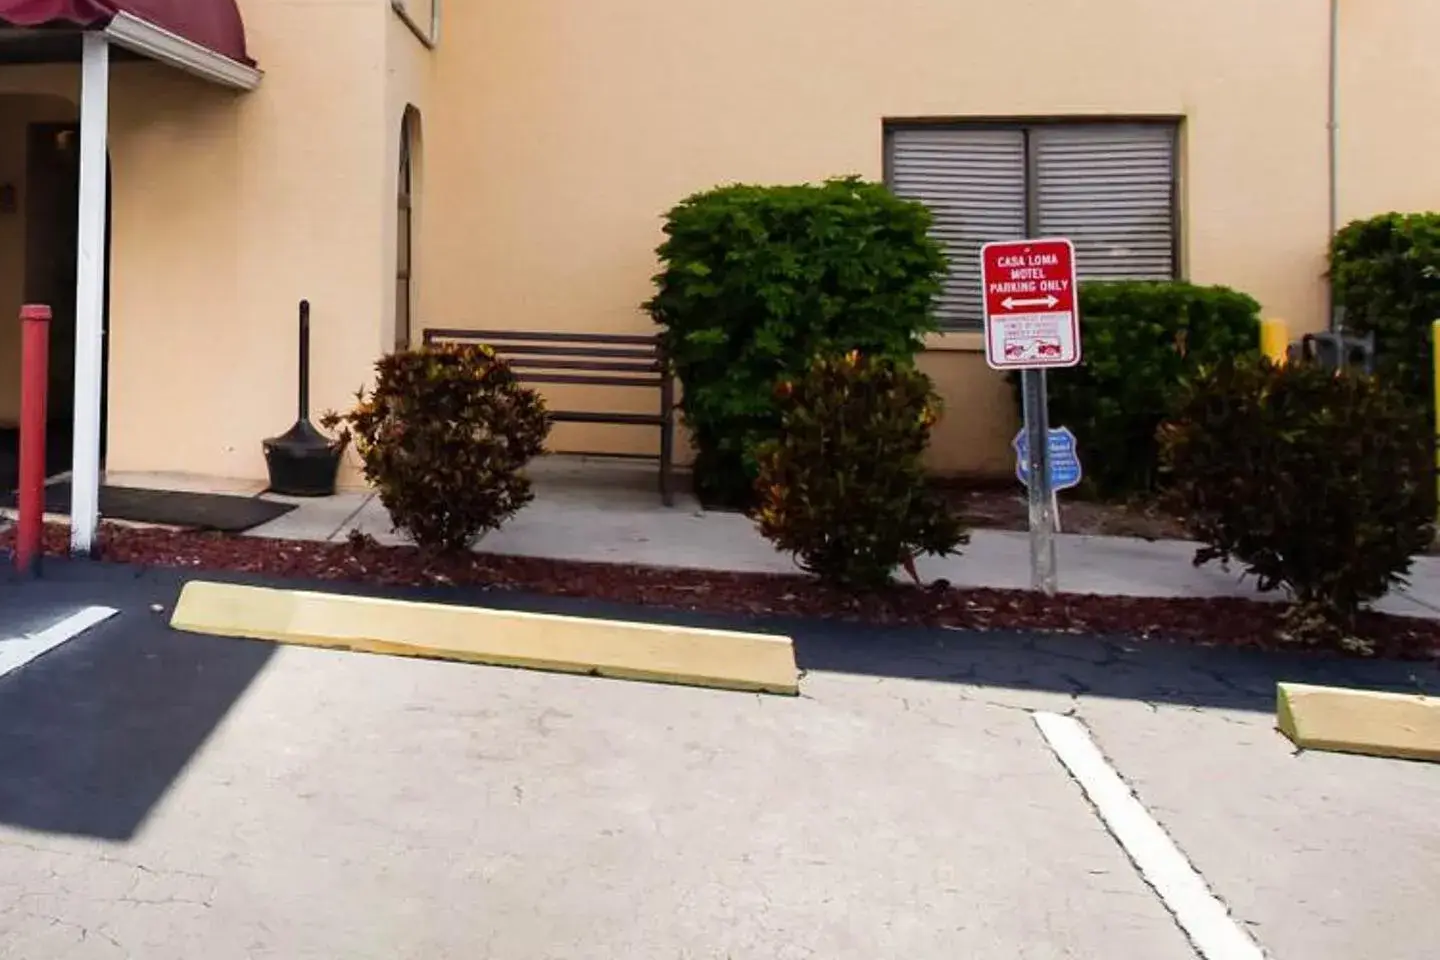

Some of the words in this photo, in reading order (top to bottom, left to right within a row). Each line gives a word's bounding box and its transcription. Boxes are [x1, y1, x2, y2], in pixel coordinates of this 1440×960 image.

[997, 255, 1024, 267] CASA
[1029, 253, 1058, 266] LOMA
[1011, 268, 1046, 280] MOTEL
[990, 281, 1036, 293] PARKING
[1040, 280, 1068, 291] ONLY
